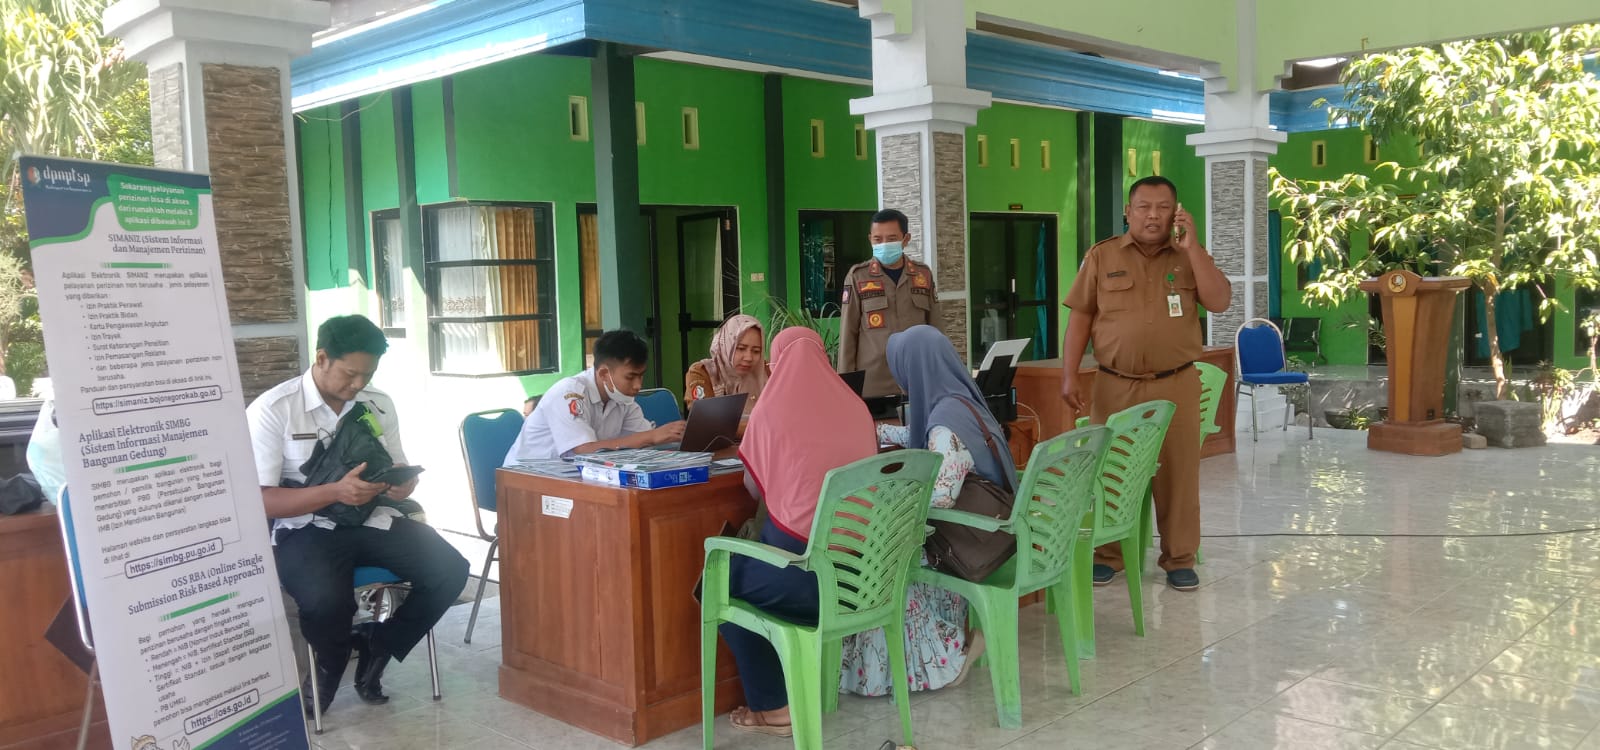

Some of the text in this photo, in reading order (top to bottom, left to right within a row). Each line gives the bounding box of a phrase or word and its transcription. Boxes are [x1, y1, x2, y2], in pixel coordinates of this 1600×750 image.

[108, 234, 141, 243] SIMANIZ
[170, 235, 203, 245] Informasi
[112, 245, 126, 253] dan
[128, 246, 170, 255] Manajemen
[62, 272, 86, 280] Aplikasi
[126, 271, 149, 279] SIMANIZ
[154, 272, 184, 280] merupakan
[188, 272, 208, 280] aplikasi
[63, 282, 95, 290] pelayanan
[96, 282, 124, 290] perizinan
[65, 293, 81, 301] yang
[79, 418, 191, 444] Aplikasi Elektronik SIMBG
[80, 428, 208, 456] (Sistem Informasi Manajemen
[82, 446, 167, 469] Bangunan Gedung)
[91, 480, 112, 490] SIMBG
[117, 474, 149, 485] merupakan
[155, 470, 176, 479] aplikasi
[156, 478, 184, 488] bangunan
[129, 543, 216, 574] https://simbg.pu.go.id
[171, 553, 263, 589] OSS RBA (Online Single
[127, 565, 265, 616] Submission Risk Based Approach)
[138, 634, 151, 645] Bagi
[190, 694, 252, 730] https://oss.go.id
